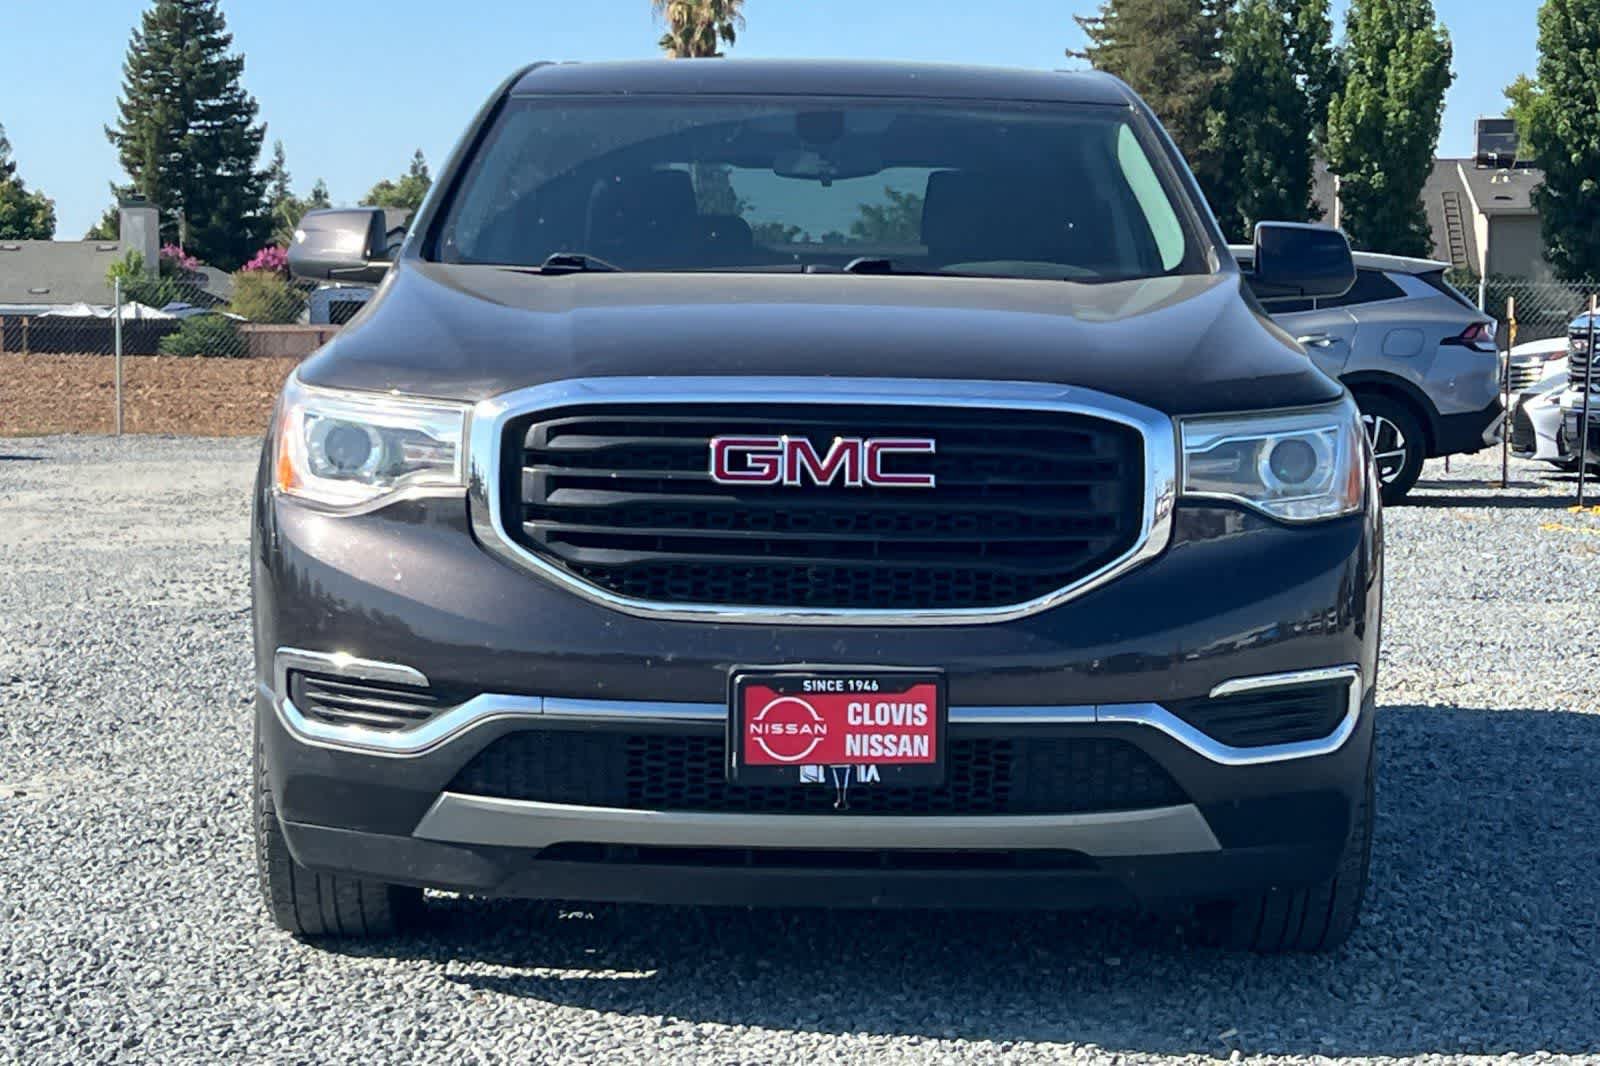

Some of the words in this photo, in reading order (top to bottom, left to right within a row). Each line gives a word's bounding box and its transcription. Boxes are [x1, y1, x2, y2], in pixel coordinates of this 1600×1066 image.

[711, 435, 936, 488] GMC
[803, 680, 844, 692] SINCE
[849, 679, 879, 692] 1946
[847, 702, 928, 726] CLOVIS
[750, 723, 828, 735] NISSAN
[845, 733, 929, 757] NISSAN
